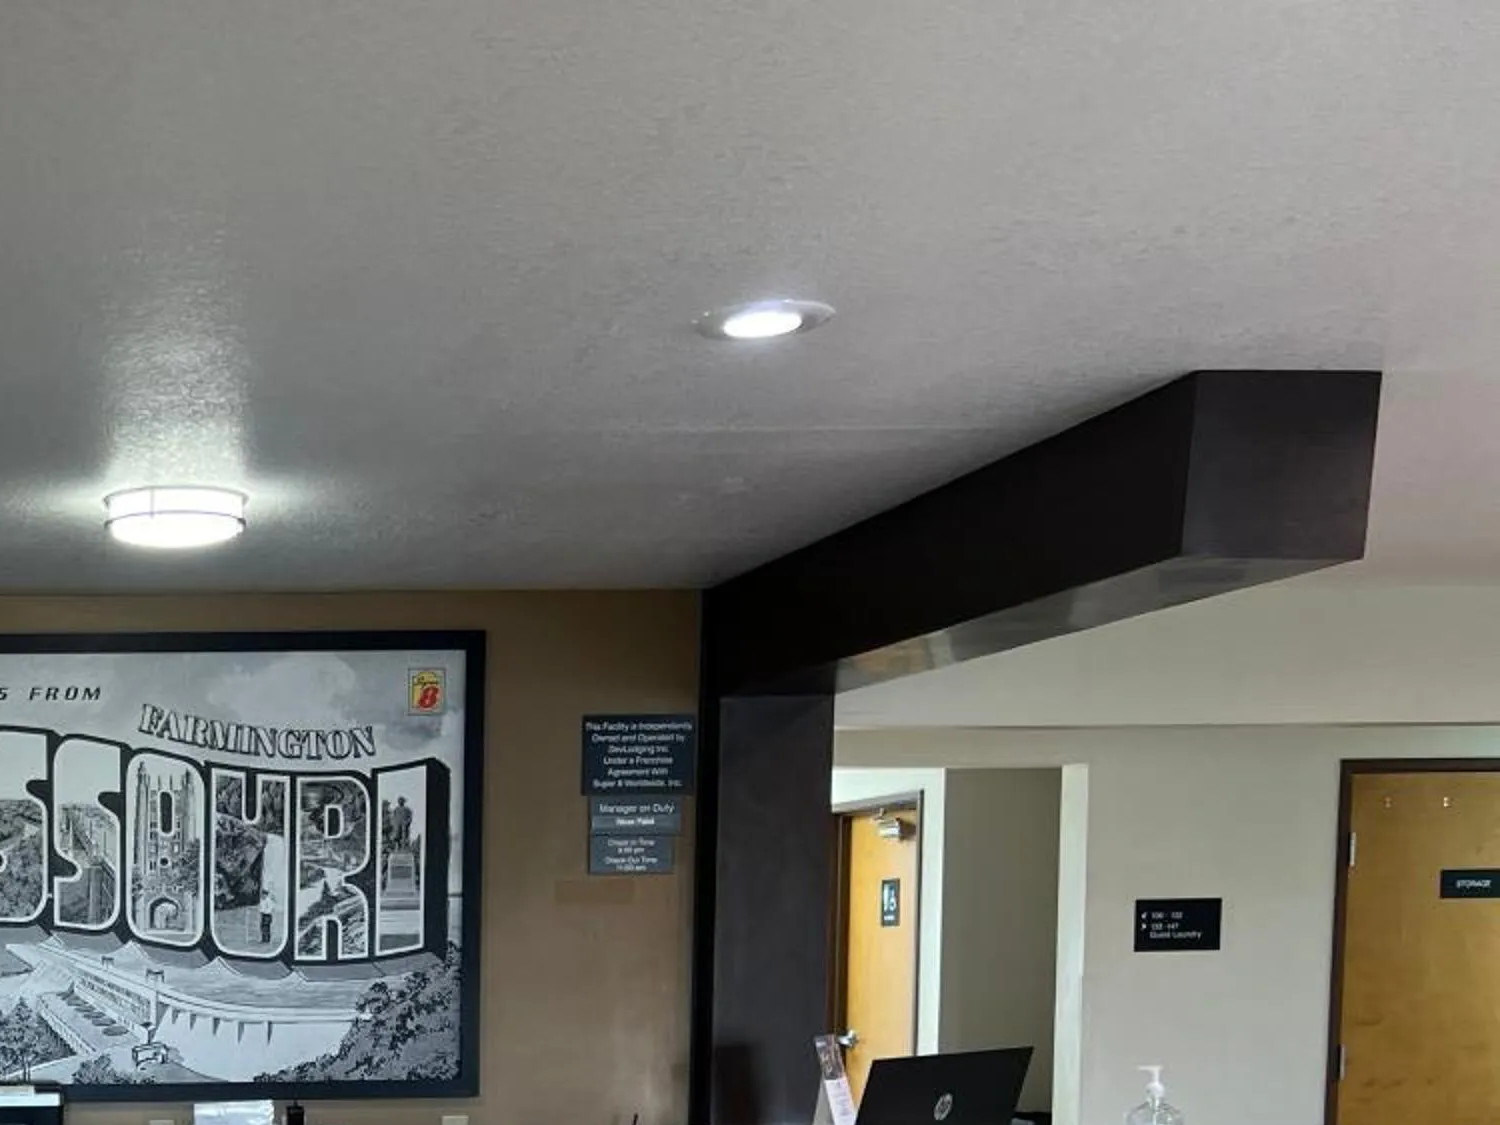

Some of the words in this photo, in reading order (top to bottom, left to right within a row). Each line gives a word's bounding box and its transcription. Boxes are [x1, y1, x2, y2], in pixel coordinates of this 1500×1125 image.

[29, 686, 102, 702] FROM
[418, 686, 440, 709] 8
[138, 703, 376, 761] FARMINGTON
[599, 803, 637, 814] Manager
[639, 805, 650, 813] on
[652, 802, 675, 815] Duty
